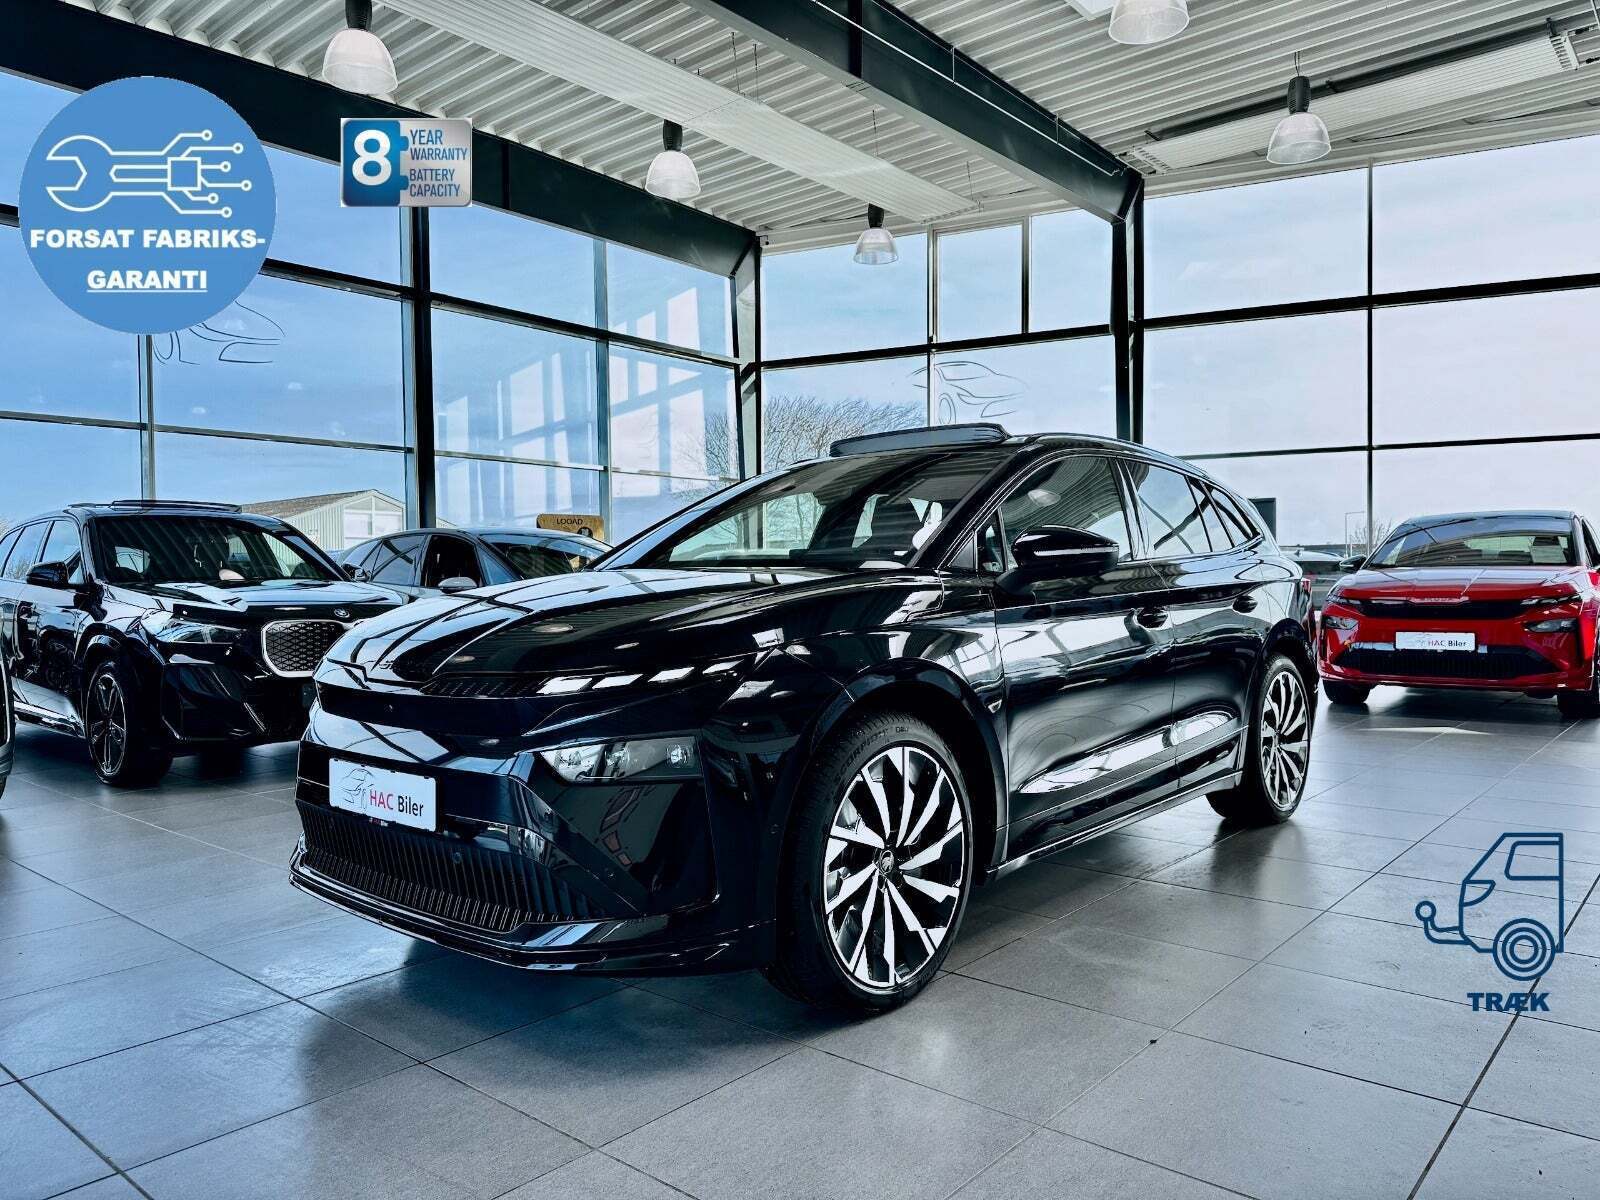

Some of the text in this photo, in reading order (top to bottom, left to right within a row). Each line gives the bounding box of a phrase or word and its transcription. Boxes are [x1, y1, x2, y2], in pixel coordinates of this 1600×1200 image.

[1448, 639, 1467, 647] Biler
[369, 790, 424, 817] HAC Biler
